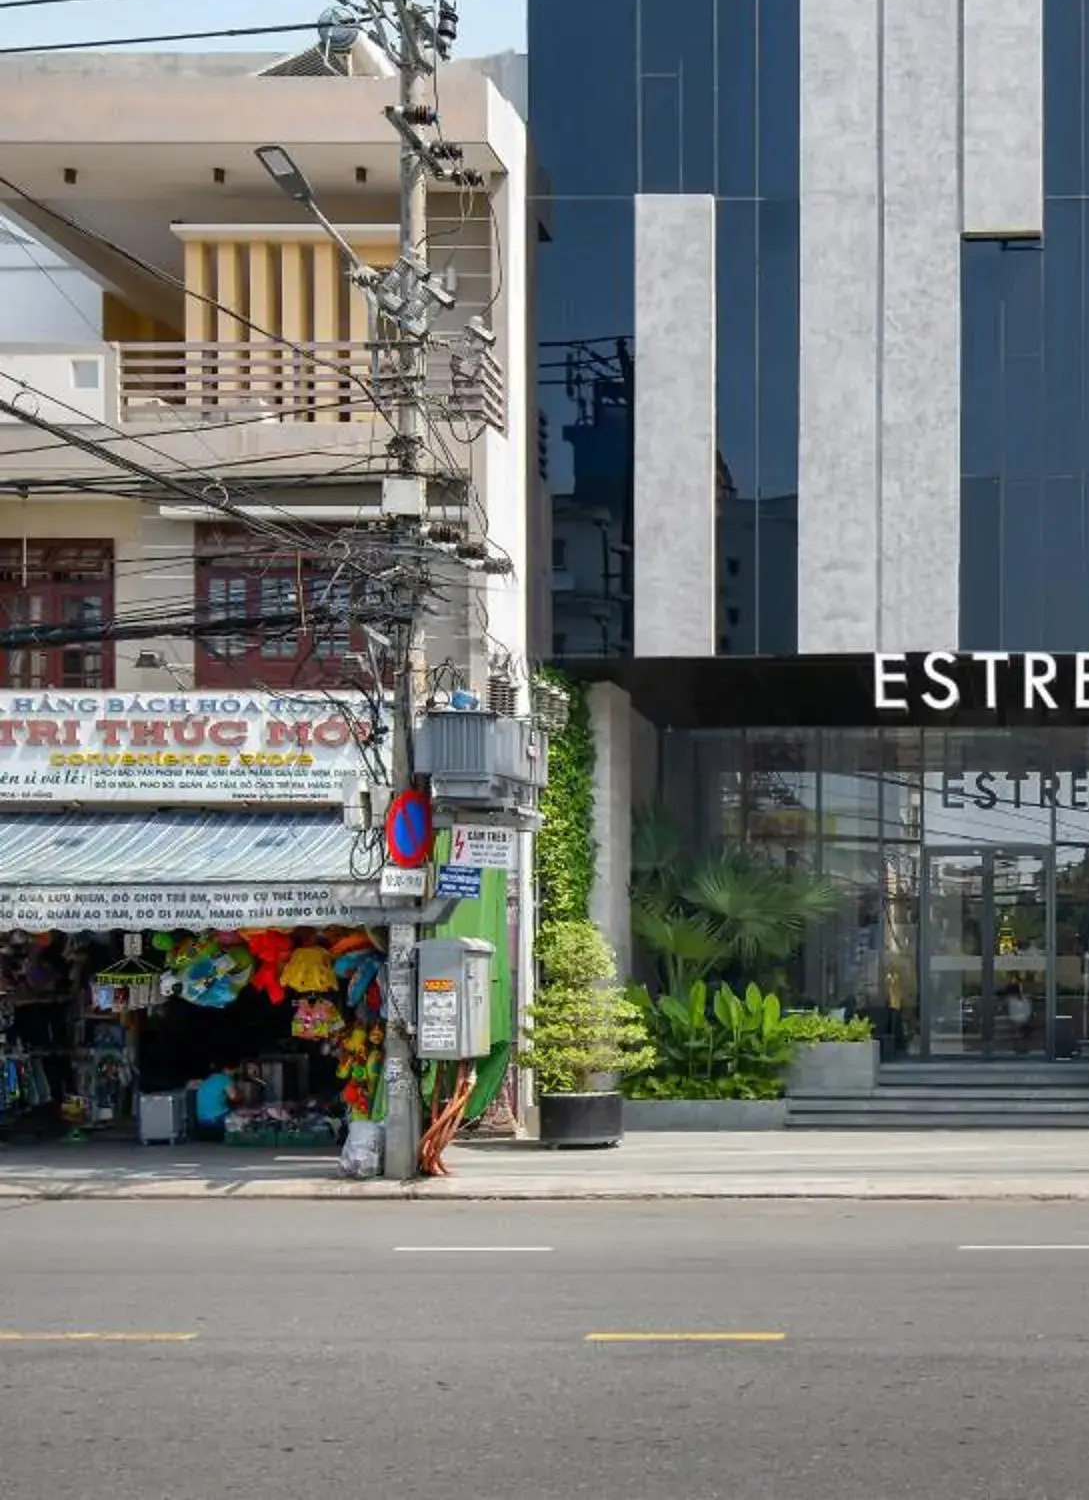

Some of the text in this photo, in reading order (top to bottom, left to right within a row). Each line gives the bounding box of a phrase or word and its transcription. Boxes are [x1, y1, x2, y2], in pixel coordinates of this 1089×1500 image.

[0, 719, 81, 748] TRI
[95, 712, 248, 749] THỨC
[51, 750, 232, 767] convenience
